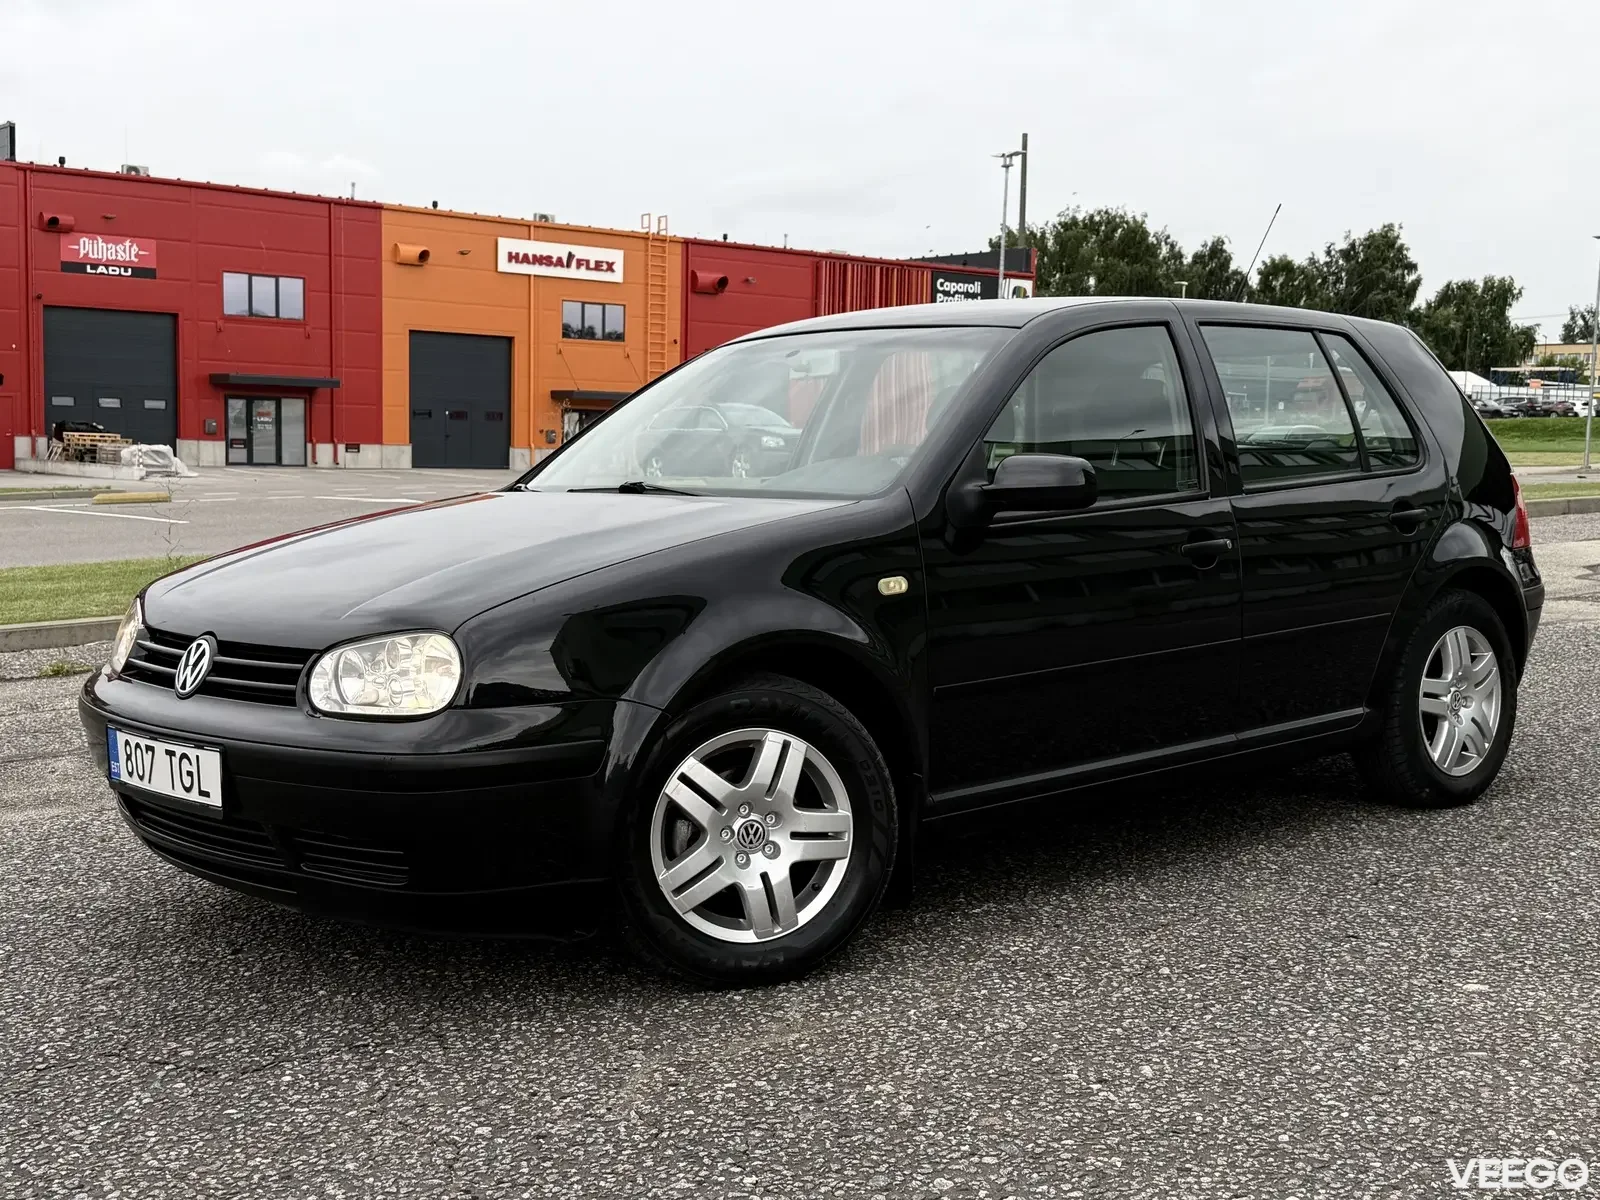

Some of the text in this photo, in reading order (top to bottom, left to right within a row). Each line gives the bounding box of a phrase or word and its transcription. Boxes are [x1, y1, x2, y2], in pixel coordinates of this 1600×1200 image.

[86, 264, 132, 276] LADU
[507, 251, 616, 273] HANSA FLEX
[936, 278, 981, 294] Caparoli
[124, 738, 211, 798] 807 TGL
